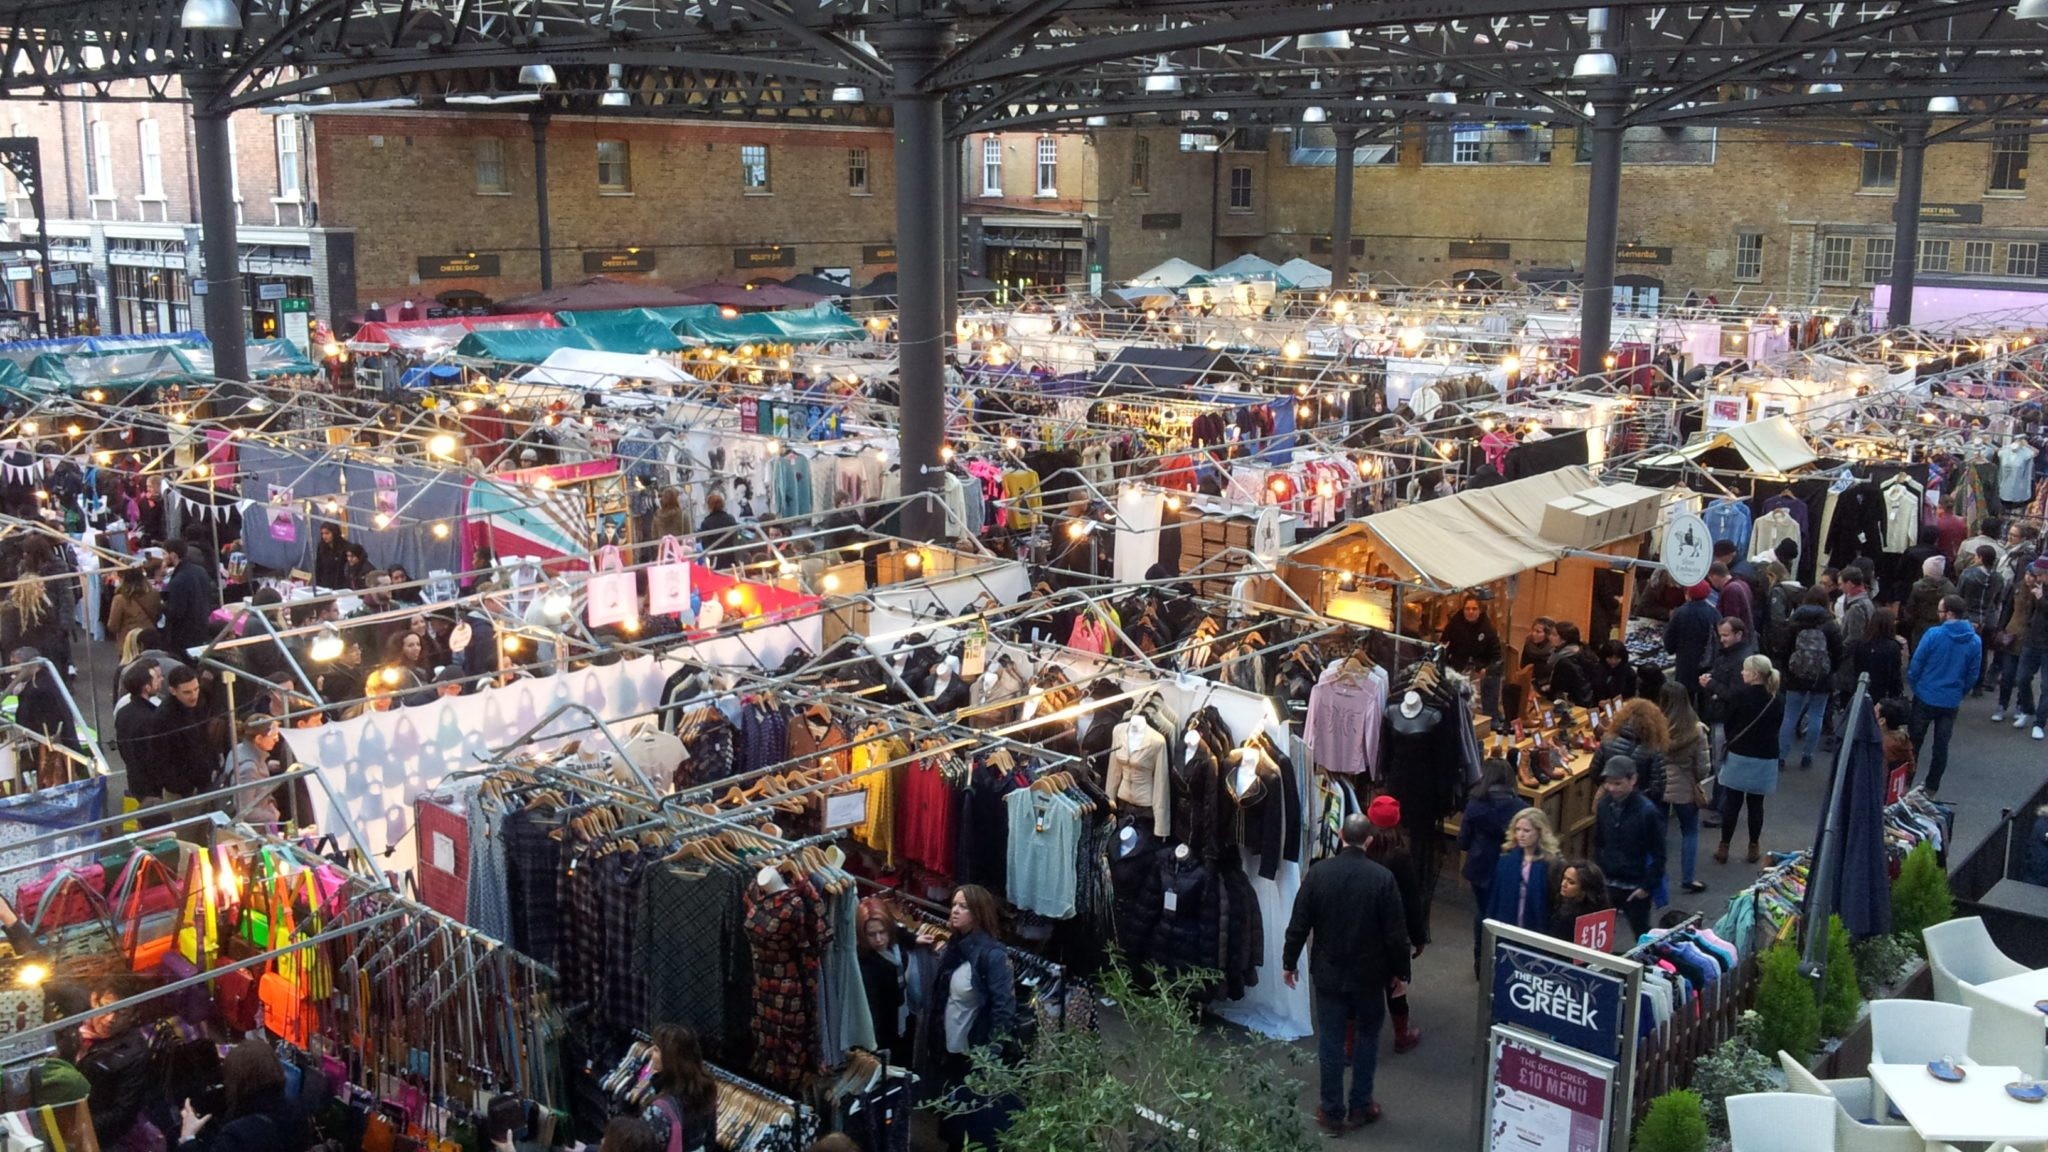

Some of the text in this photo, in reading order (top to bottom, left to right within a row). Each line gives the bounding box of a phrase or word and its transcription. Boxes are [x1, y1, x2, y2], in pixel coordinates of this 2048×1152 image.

[1581, 921, 1608, 949] £15
[1514, 970, 1577, 1003] THE REAL
[1509, 982, 1599, 1031] GREEK
[1519, 1067, 1543, 1090] £10
[1546, 1076, 1588, 1106] MENU
[1520, 1057, 1589, 1088] THE REAL GREEK
